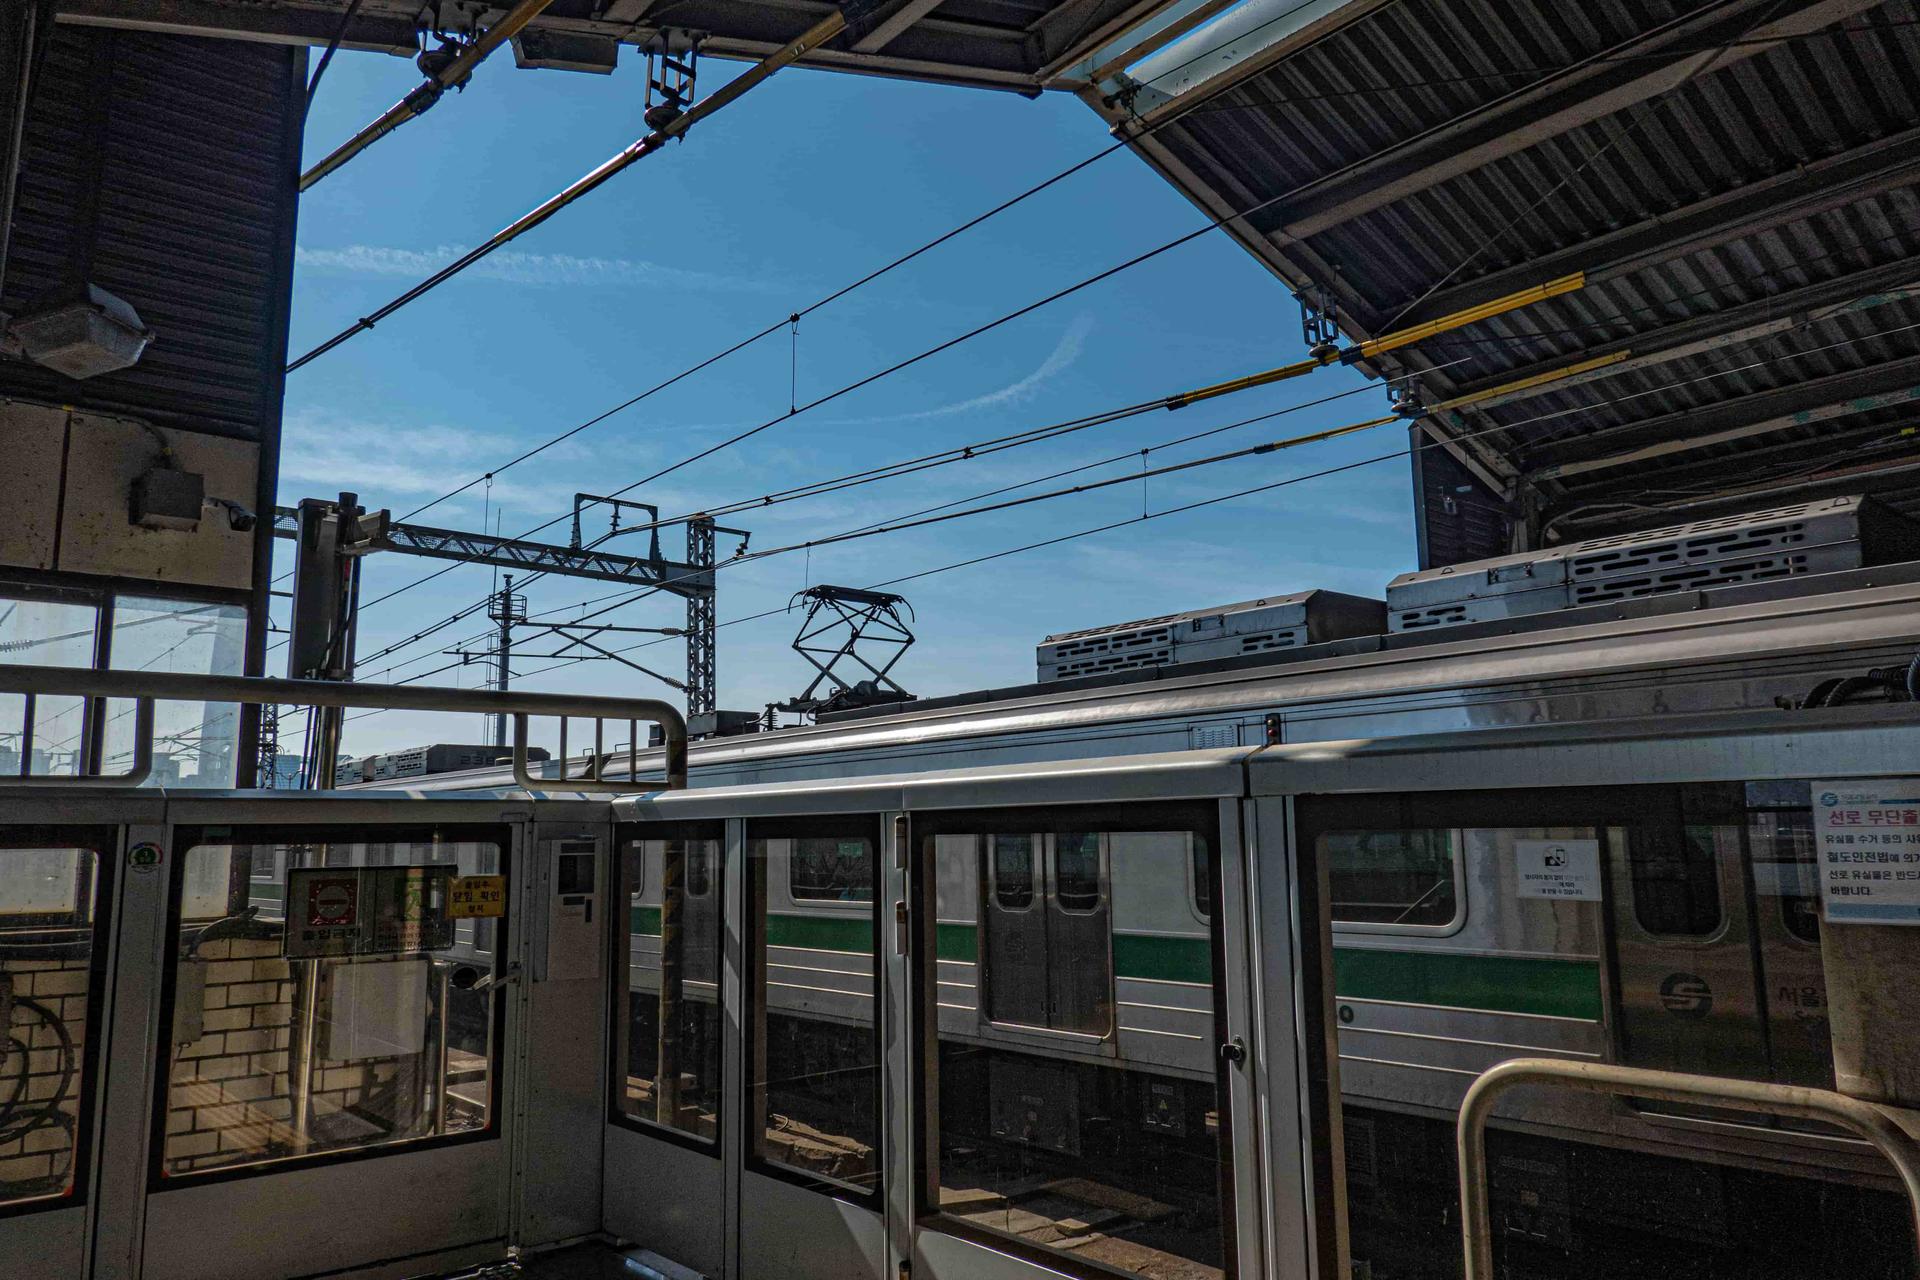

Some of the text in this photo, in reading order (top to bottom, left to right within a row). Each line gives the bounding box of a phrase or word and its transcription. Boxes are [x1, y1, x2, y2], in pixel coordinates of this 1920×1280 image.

[1829, 809, 1920, 825] 선로 무단출
[1825, 834, 1854, 844] 유실물
[1858, 834, 1877, 844] 수거
[1829, 870, 1848, 880] 선로
[1852, 870, 1891, 880] 유실물은
[1779, 986, 1828, 1007] 서울
